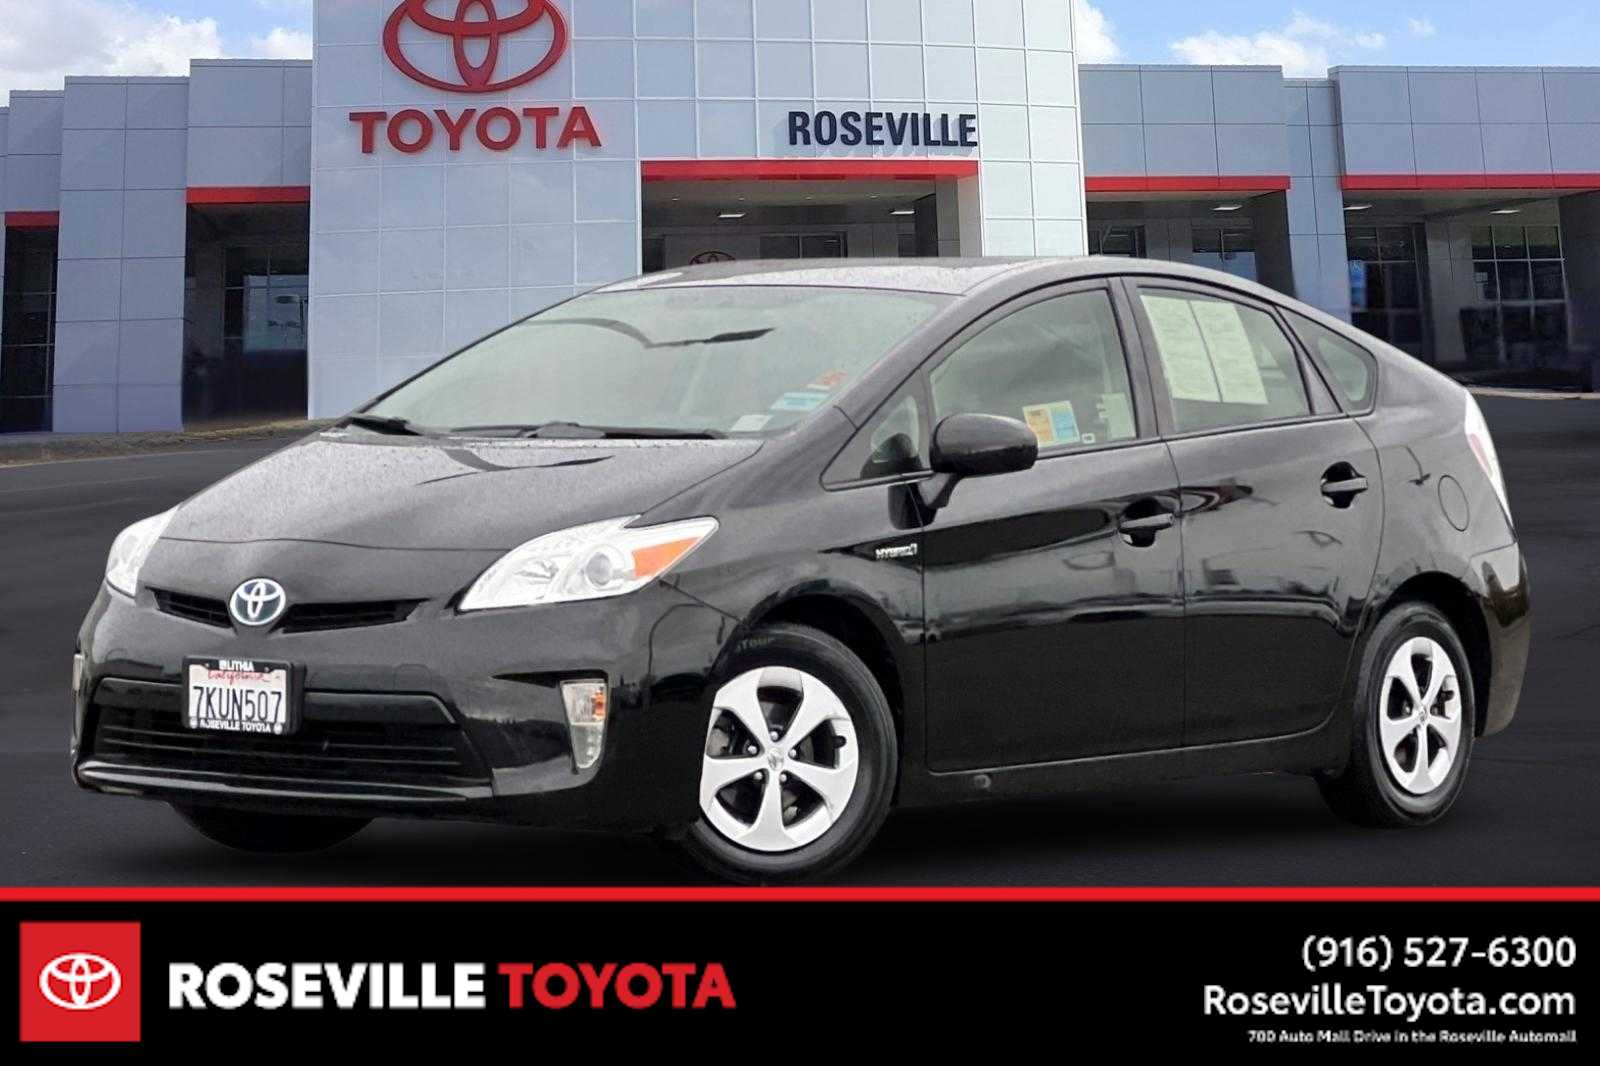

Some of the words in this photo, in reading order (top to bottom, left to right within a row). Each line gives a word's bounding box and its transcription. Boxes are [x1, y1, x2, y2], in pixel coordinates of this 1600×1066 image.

[350, 106, 603, 154] TOYOTA
[788, 111, 978, 147] ROSEVILLE
[193, 685, 282, 725] 7KUN507
